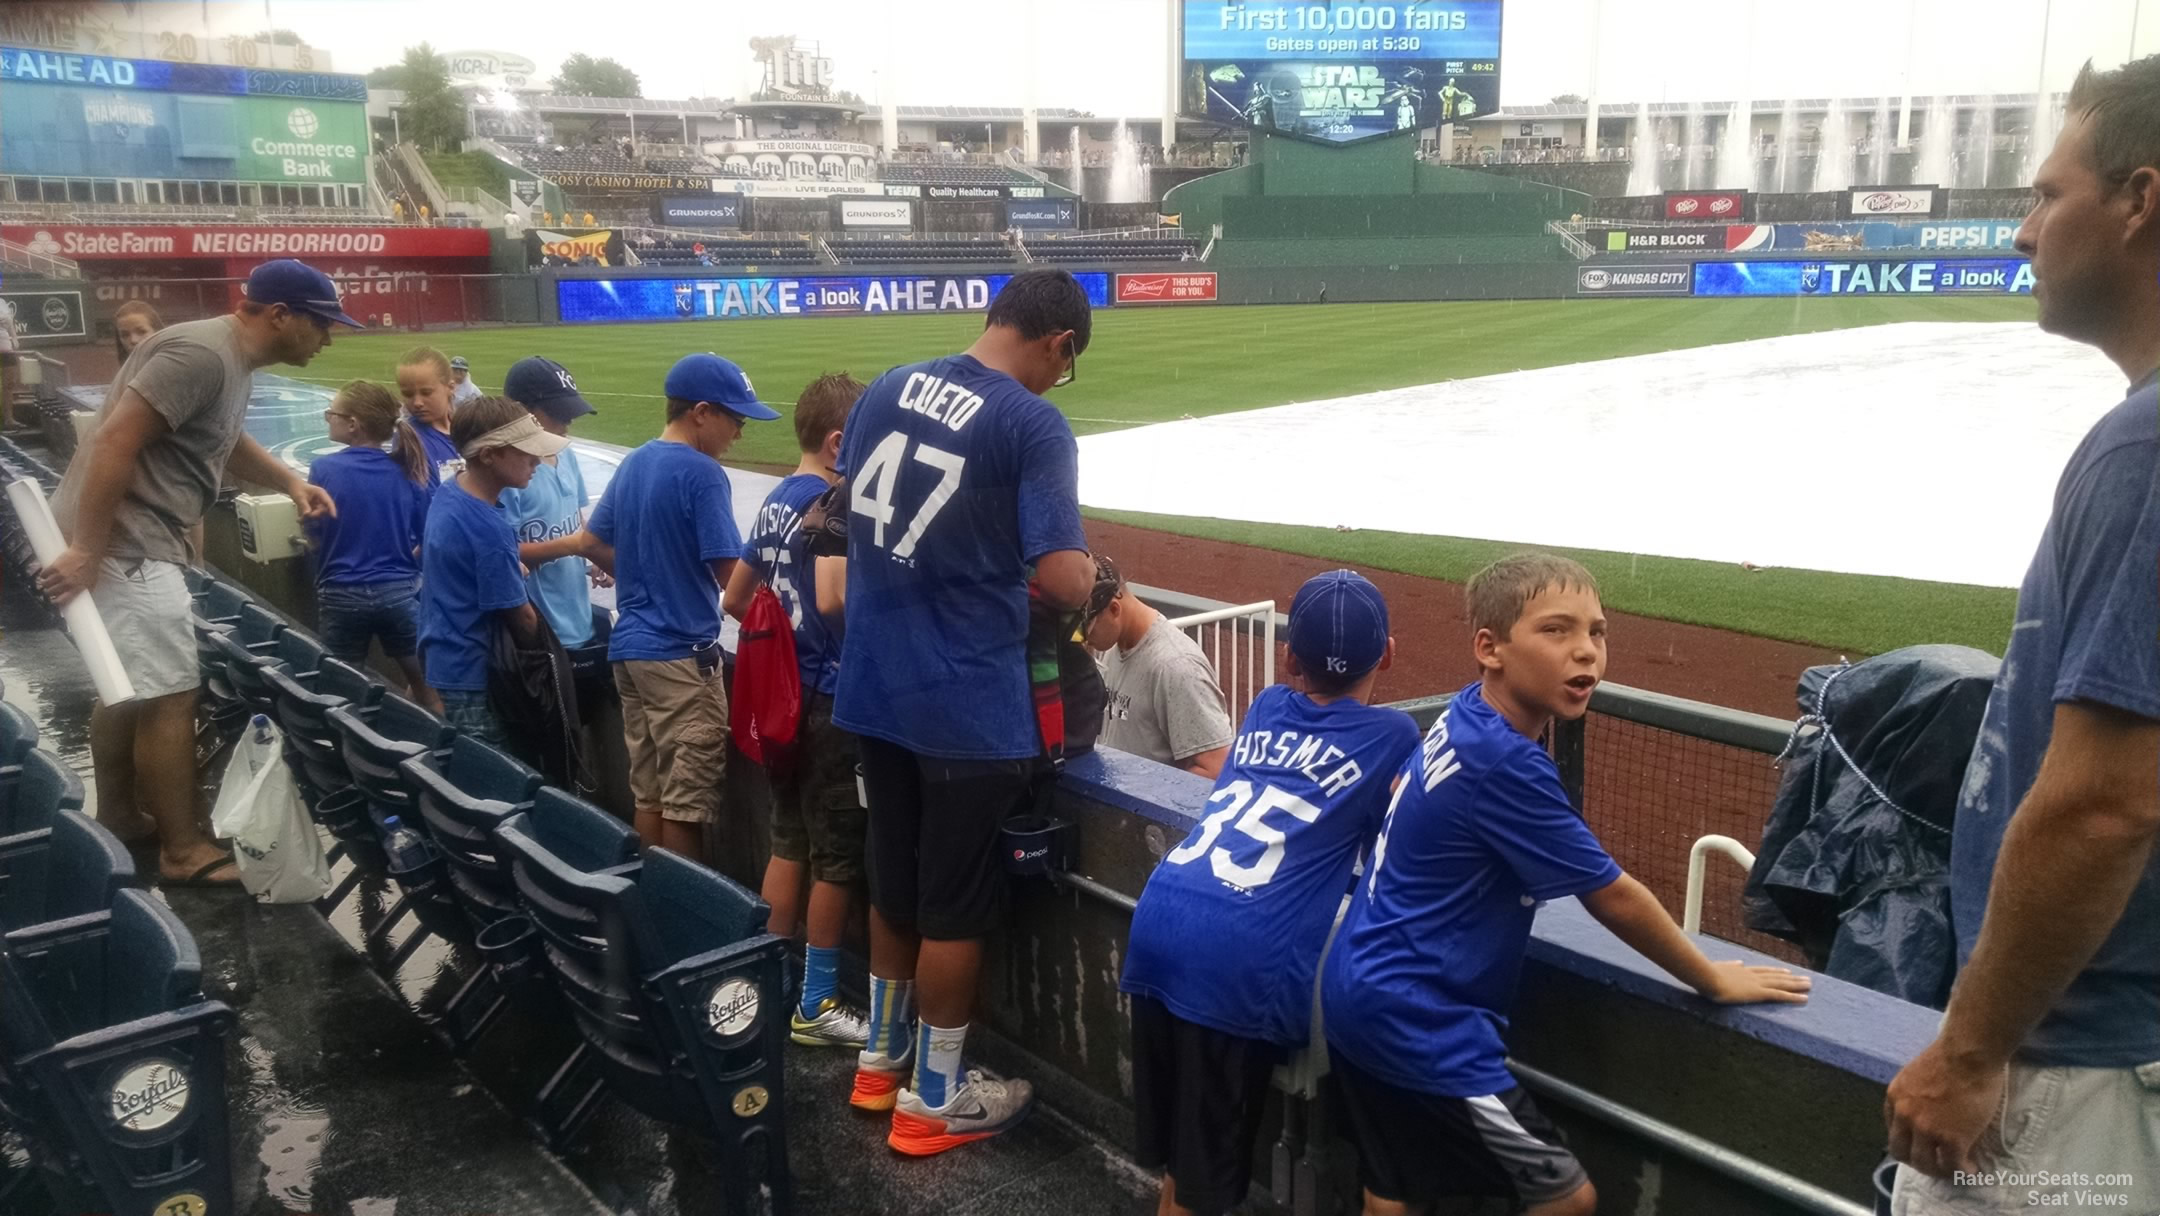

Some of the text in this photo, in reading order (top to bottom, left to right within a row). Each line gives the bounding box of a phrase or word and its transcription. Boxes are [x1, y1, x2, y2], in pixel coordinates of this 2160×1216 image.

[1220, 6, 1467, 34] First 10,000 fans
[159, 32, 197, 62] 20
[227, 36, 258, 66] 10
[1266, 36, 1420, 53] Gates open at 5:30
[293, 44, 313, 71] 5
[1472, 63, 1494, 71] 49:42
[15, 52, 136, 86] AHEAD
[1300, 65, 1385, 87] STAR
[780, 93, 821, 102] FOUNTAIN
[1300, 87, 1385, 109] WARS
[1329, 124, 1354, 134] 12:20
[252, 137, 356, 158] Commerce
[757, 142, 776, 151] THE
[778, 141, 823, 151] ORIGINAL
[824, 142, 848, 153] LIGHT
[283, 157, 334, 177] Bank
[585, 175, 632, 189] CASINO
[634, 177, 673, 189] HOTEL
[676, 179, 685, 190] &
[688, 179, 710, 191] SPA
[795, 185, 817, 193] LIVE
[818, 186, 866, 194] FEARLESS
[885, 185, 921, 198] TEVA
[929, 186, 1000, 199] Quality Healthcare
[1009, 187, 1044, 198] TEVA
[669, 209, 724, 218] GRUNDFOS
[192, 233, 386, 253] NEIGHBORHOOD
[1629, 234, 1706, 247] H&R BLOCK
[1920, 226, 1988, 247] PEPSI
[544, 241, 607, 258] SONIC
[1172, 277, 1212, 287] THIS BUD'S
[1588, 274, 1605, 282] FOX
[1612, 272, 1659, 285] KANSAS
[1660, 272, 1686, 284] CITY
[1824, 263, 1937, 293] TAKE
[1941, 273, 1955, 285] a
[1960, 269, 2006, 286] look
[696, 280, 801, 317] TAKE
[805, 290, 817, 306] a
[821, 286, 861, 305] look
[864, 278, 989, 312] AHEAD
[1172, 286, 1205, 296] FOR YOU.
[555, 370, 577, 391] KC
[898, 371, 984, 432] CUETO
[850, 430, 966, 559] 47
[1234, 730, 1363, 798] HOSMER
[1165, 779, 1323, 891] 35
[709, 984, 759, 1024] Royals
[111, 1068, 189, 1116] Royals
[743, 1092, 761, 1112] A
